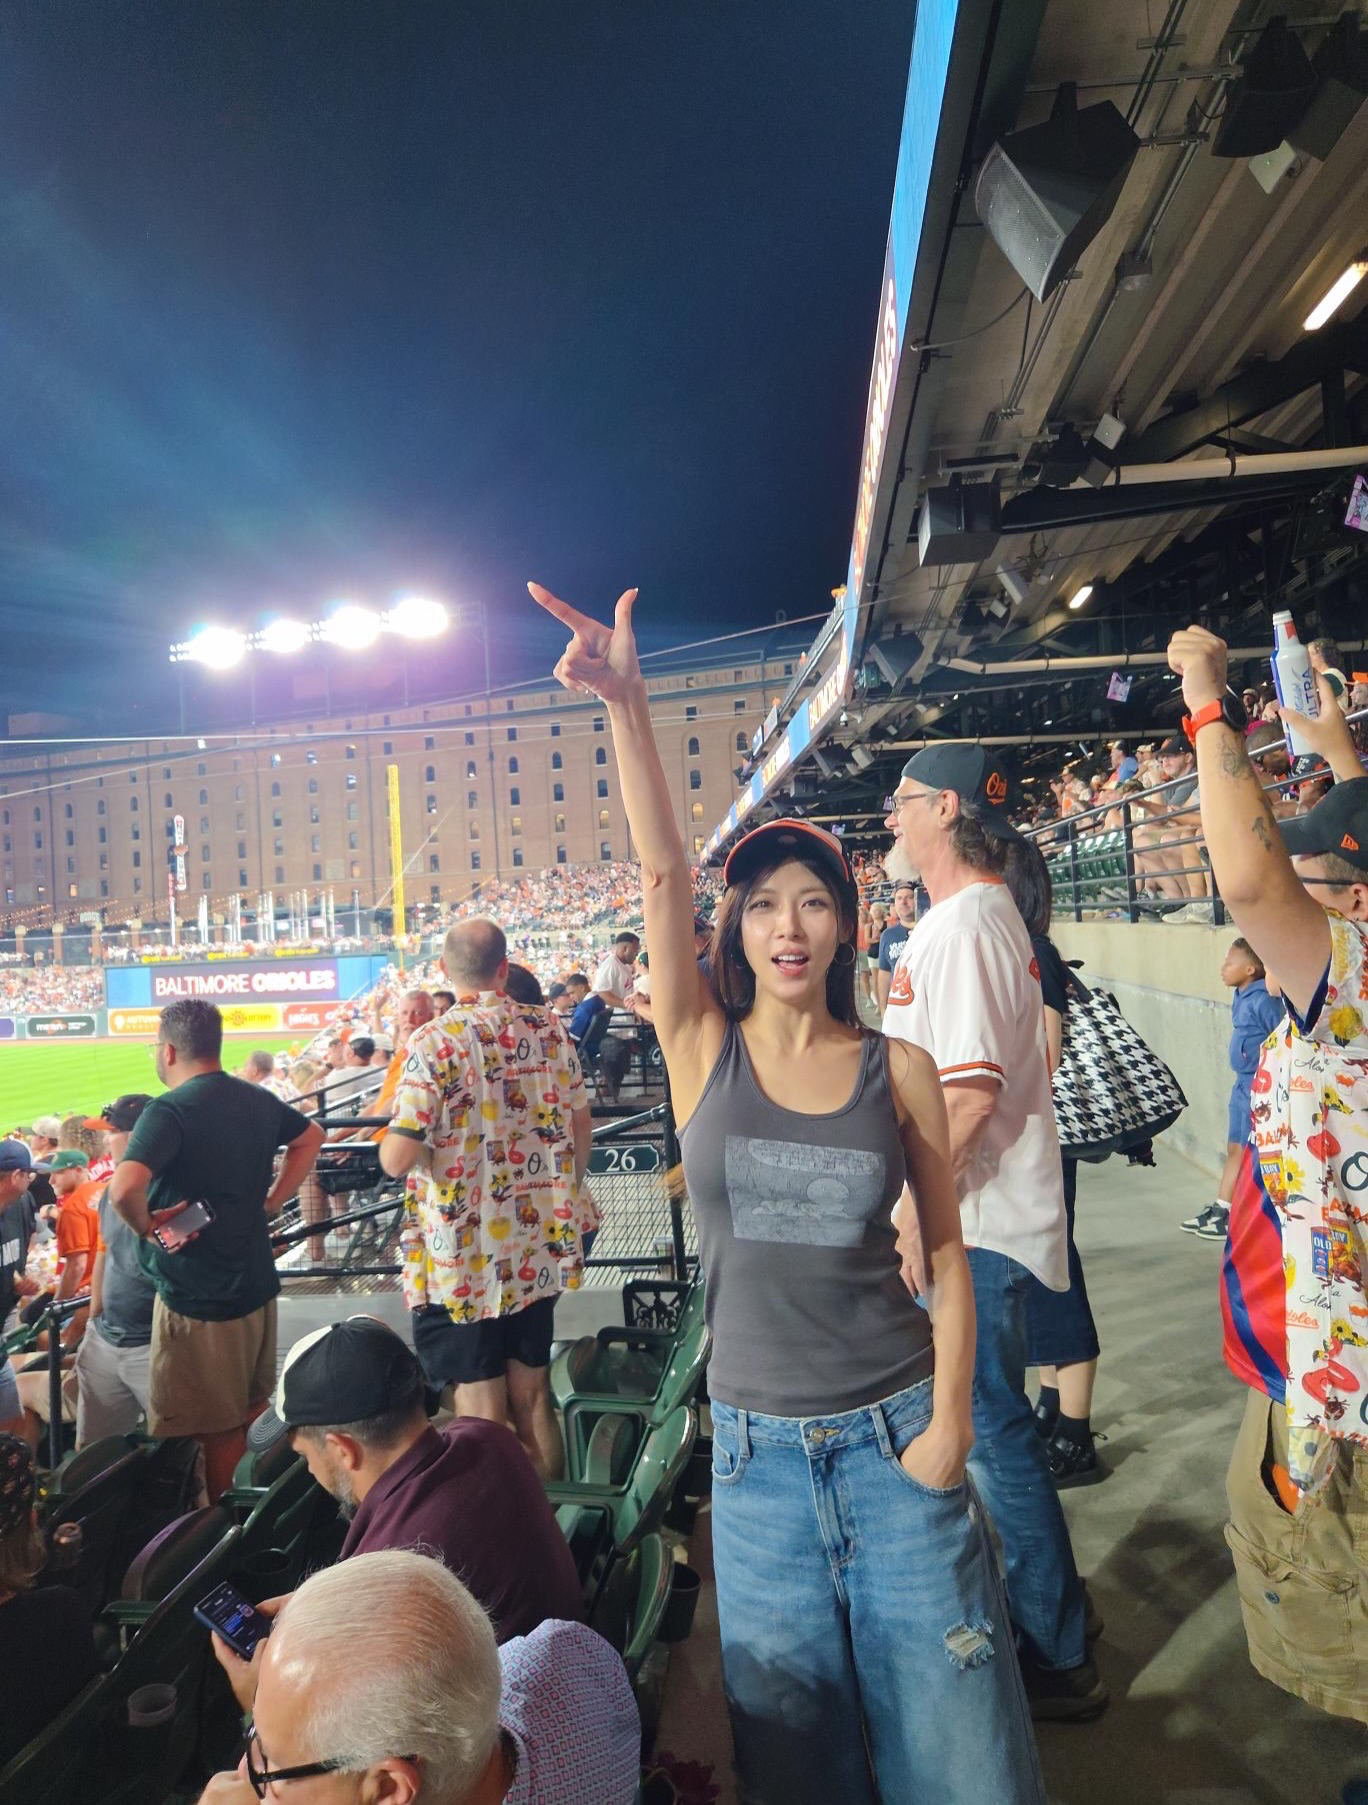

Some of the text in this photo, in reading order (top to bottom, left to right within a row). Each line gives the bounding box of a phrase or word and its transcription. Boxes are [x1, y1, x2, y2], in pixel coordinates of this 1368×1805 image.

[155, 970, 336, 996] BALTIMORE ORIOLES
[605, 1147, 636, 1172] 26
